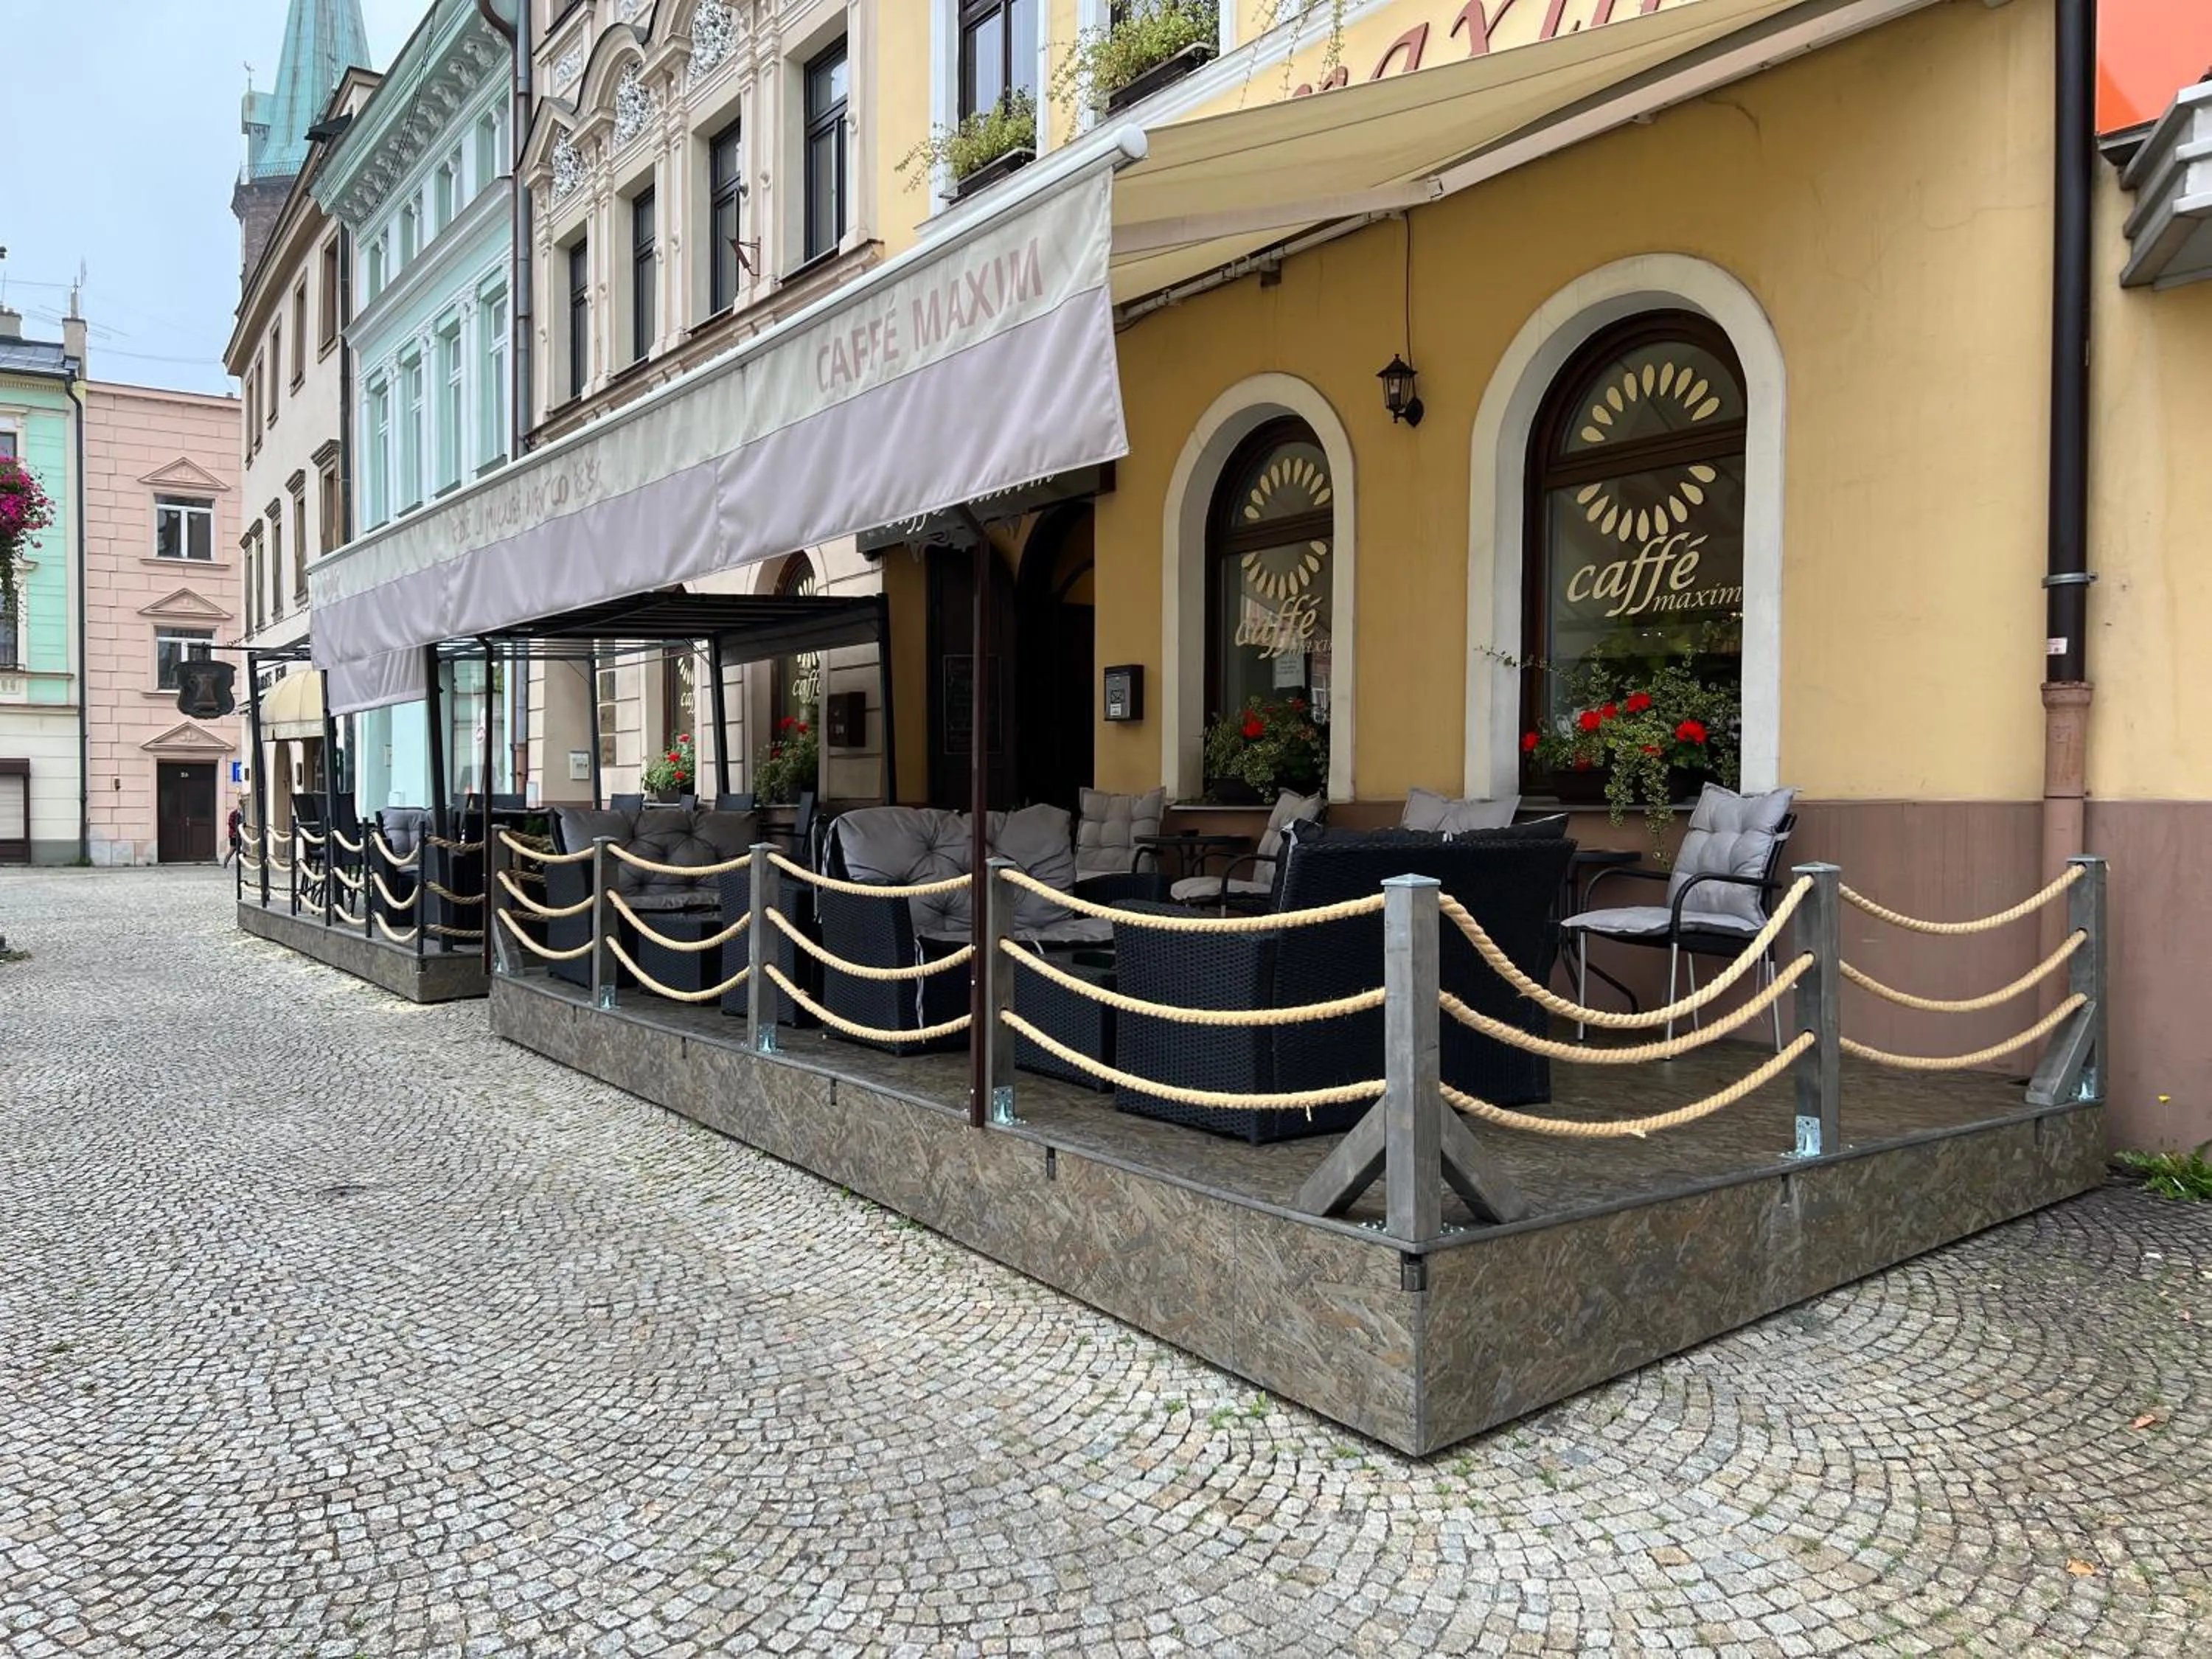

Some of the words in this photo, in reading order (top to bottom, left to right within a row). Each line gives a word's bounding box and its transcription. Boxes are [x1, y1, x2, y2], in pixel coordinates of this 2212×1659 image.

[816, 293, 900, 393] CAFFÉ
[911, 237, 1043, 352] MAXIM
[1566, 532, 1709, 617] caffé
[1653, 582, 1742, 613] maxim
[1234, 594, 1323, 659] caffé
